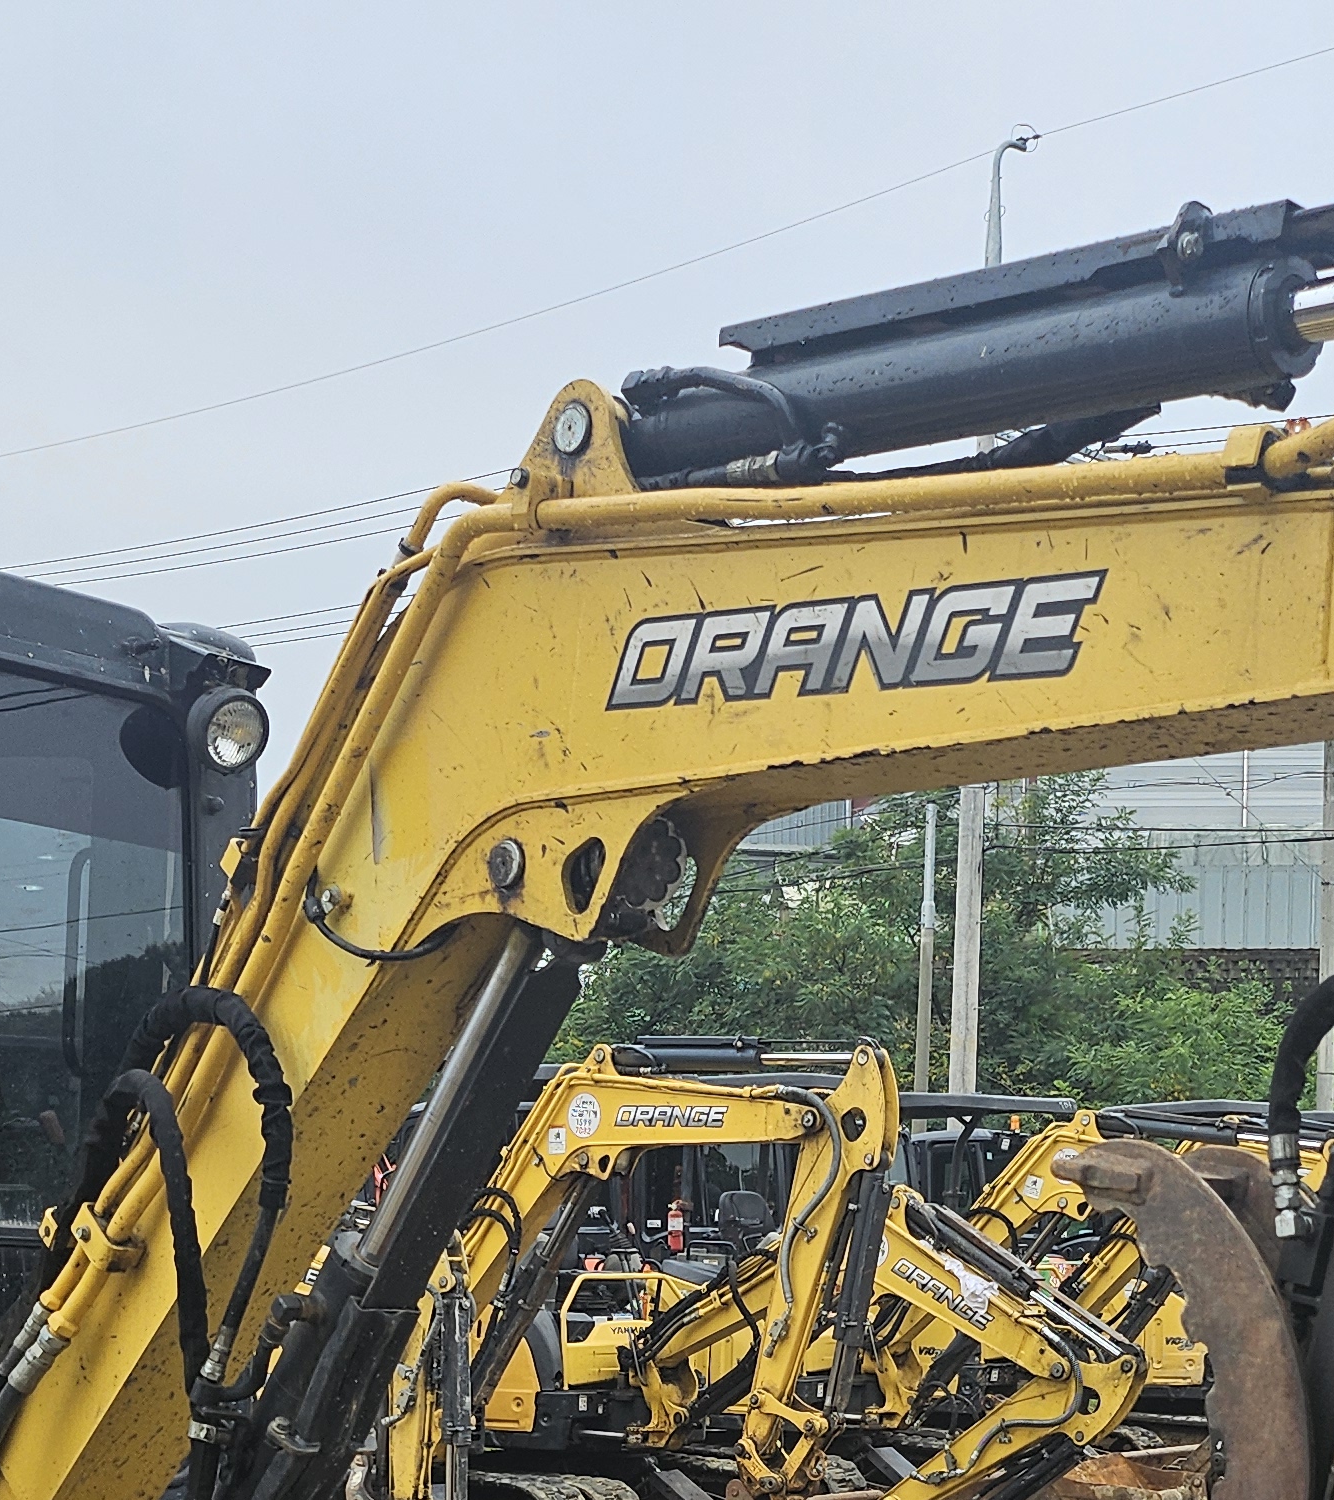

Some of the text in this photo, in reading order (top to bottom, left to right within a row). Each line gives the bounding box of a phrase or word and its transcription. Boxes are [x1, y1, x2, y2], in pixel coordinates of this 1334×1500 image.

[605, 568, 1109, 711] ORANGE
[614, 1105, 728, 1127] ORANGE
[891, 1257, 995, 1331] ORANGE
